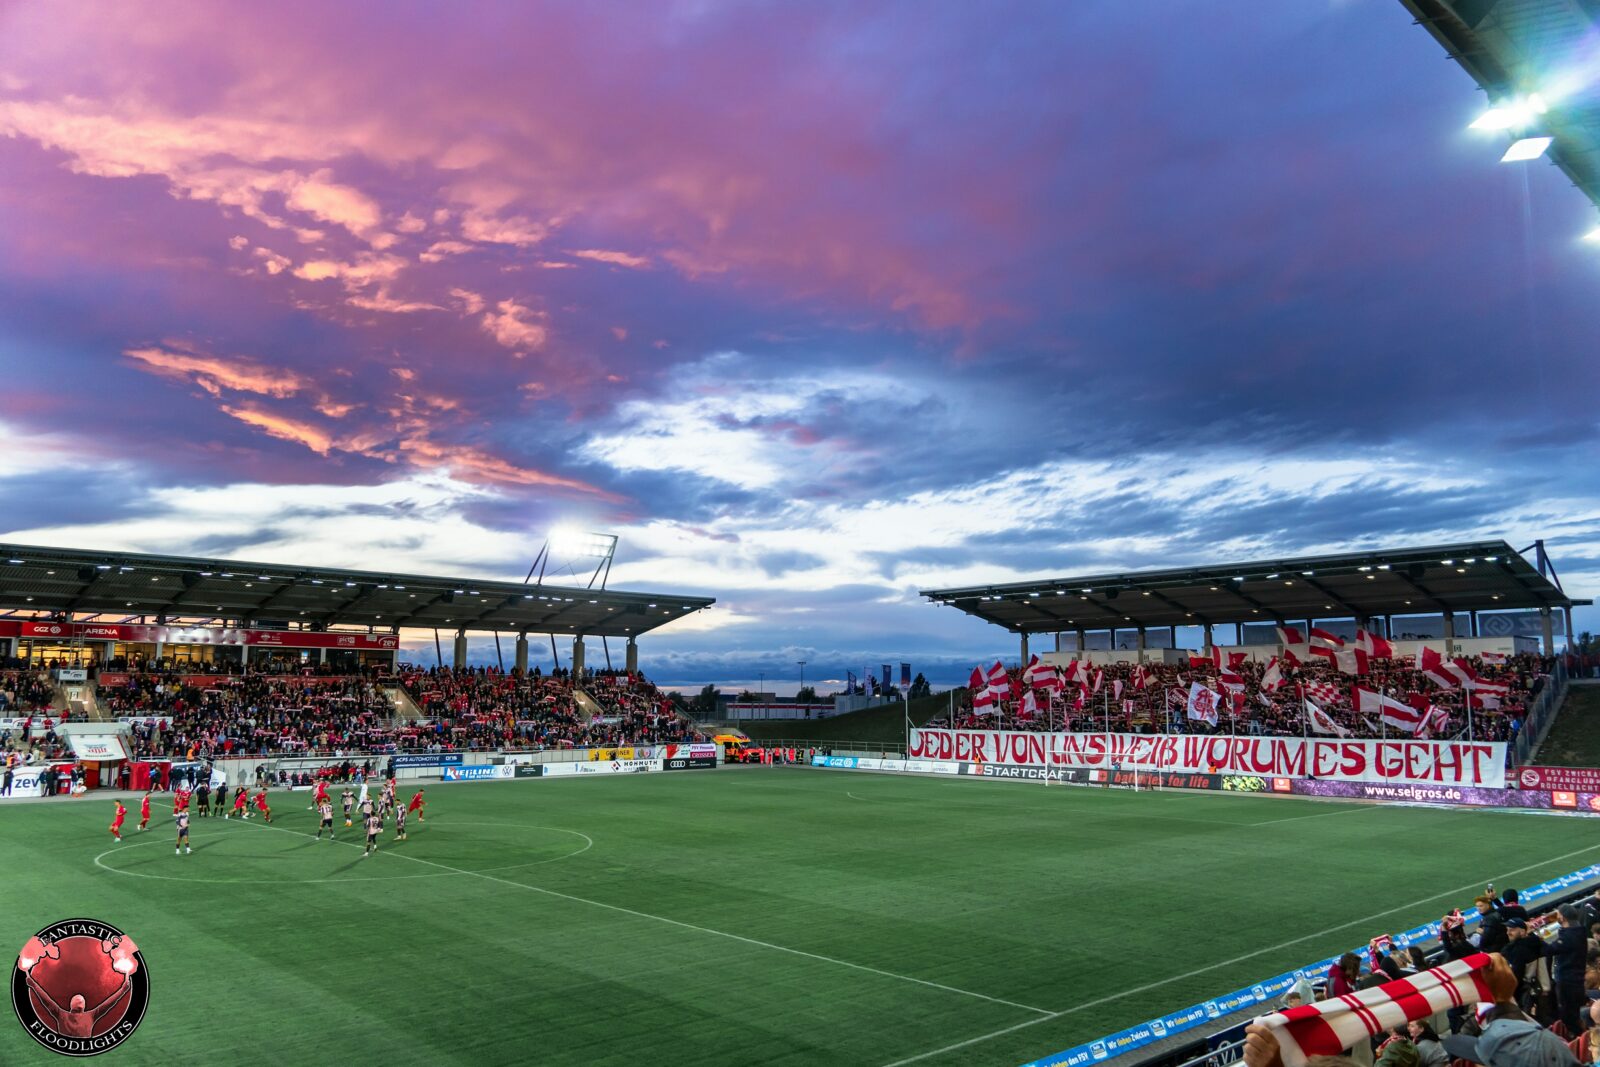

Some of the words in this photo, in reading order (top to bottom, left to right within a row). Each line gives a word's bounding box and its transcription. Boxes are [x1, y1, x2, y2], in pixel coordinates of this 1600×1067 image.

[382, 639, 397, 647] zev
[830, 758, 844, 766] GGZ
[910, 731, 989, 761] JEDER
[993, 734, 1046, 764] VON
[1052, 735, 1106, 765] UNS
[1184, 737, 1305, 776] WORUM
[1313, 742, 1366, 777] ES
[1374, 743, 1493, 783] GEHT
[983, 765, 1076, 780] STARTCRAFT
[1564, 769, 1600, 778] ZWICKA
[14, 775, 39, 789] zev
[1168, 775, 1186, 787] for
[1189, 775, 1210, 788] life
[1364, 785, 1461, 800] www.selgros.de
[1218, 1001, 1227, 1010] Wir
[1226, 998, 1239, 1009] lieben
[1237, 993, 1254, 1005] Zwickau
[1165, 1019, 1176, 1029] Wir
[1174, 1016, 1189, 1026] lieben
[1187, 1013, 1196, 1021] den
[1194, 1009, 1204, 1019] FSV
[1106, 1040, 1118, 1050] Wir
[1116, 1036, 1132, 1047] lieben
[1130, 1029, 1151, 1042] Zwickau
[1067, 1056, 1079, 1066] den
[1077, 1051, 1089, 1063] FSV
